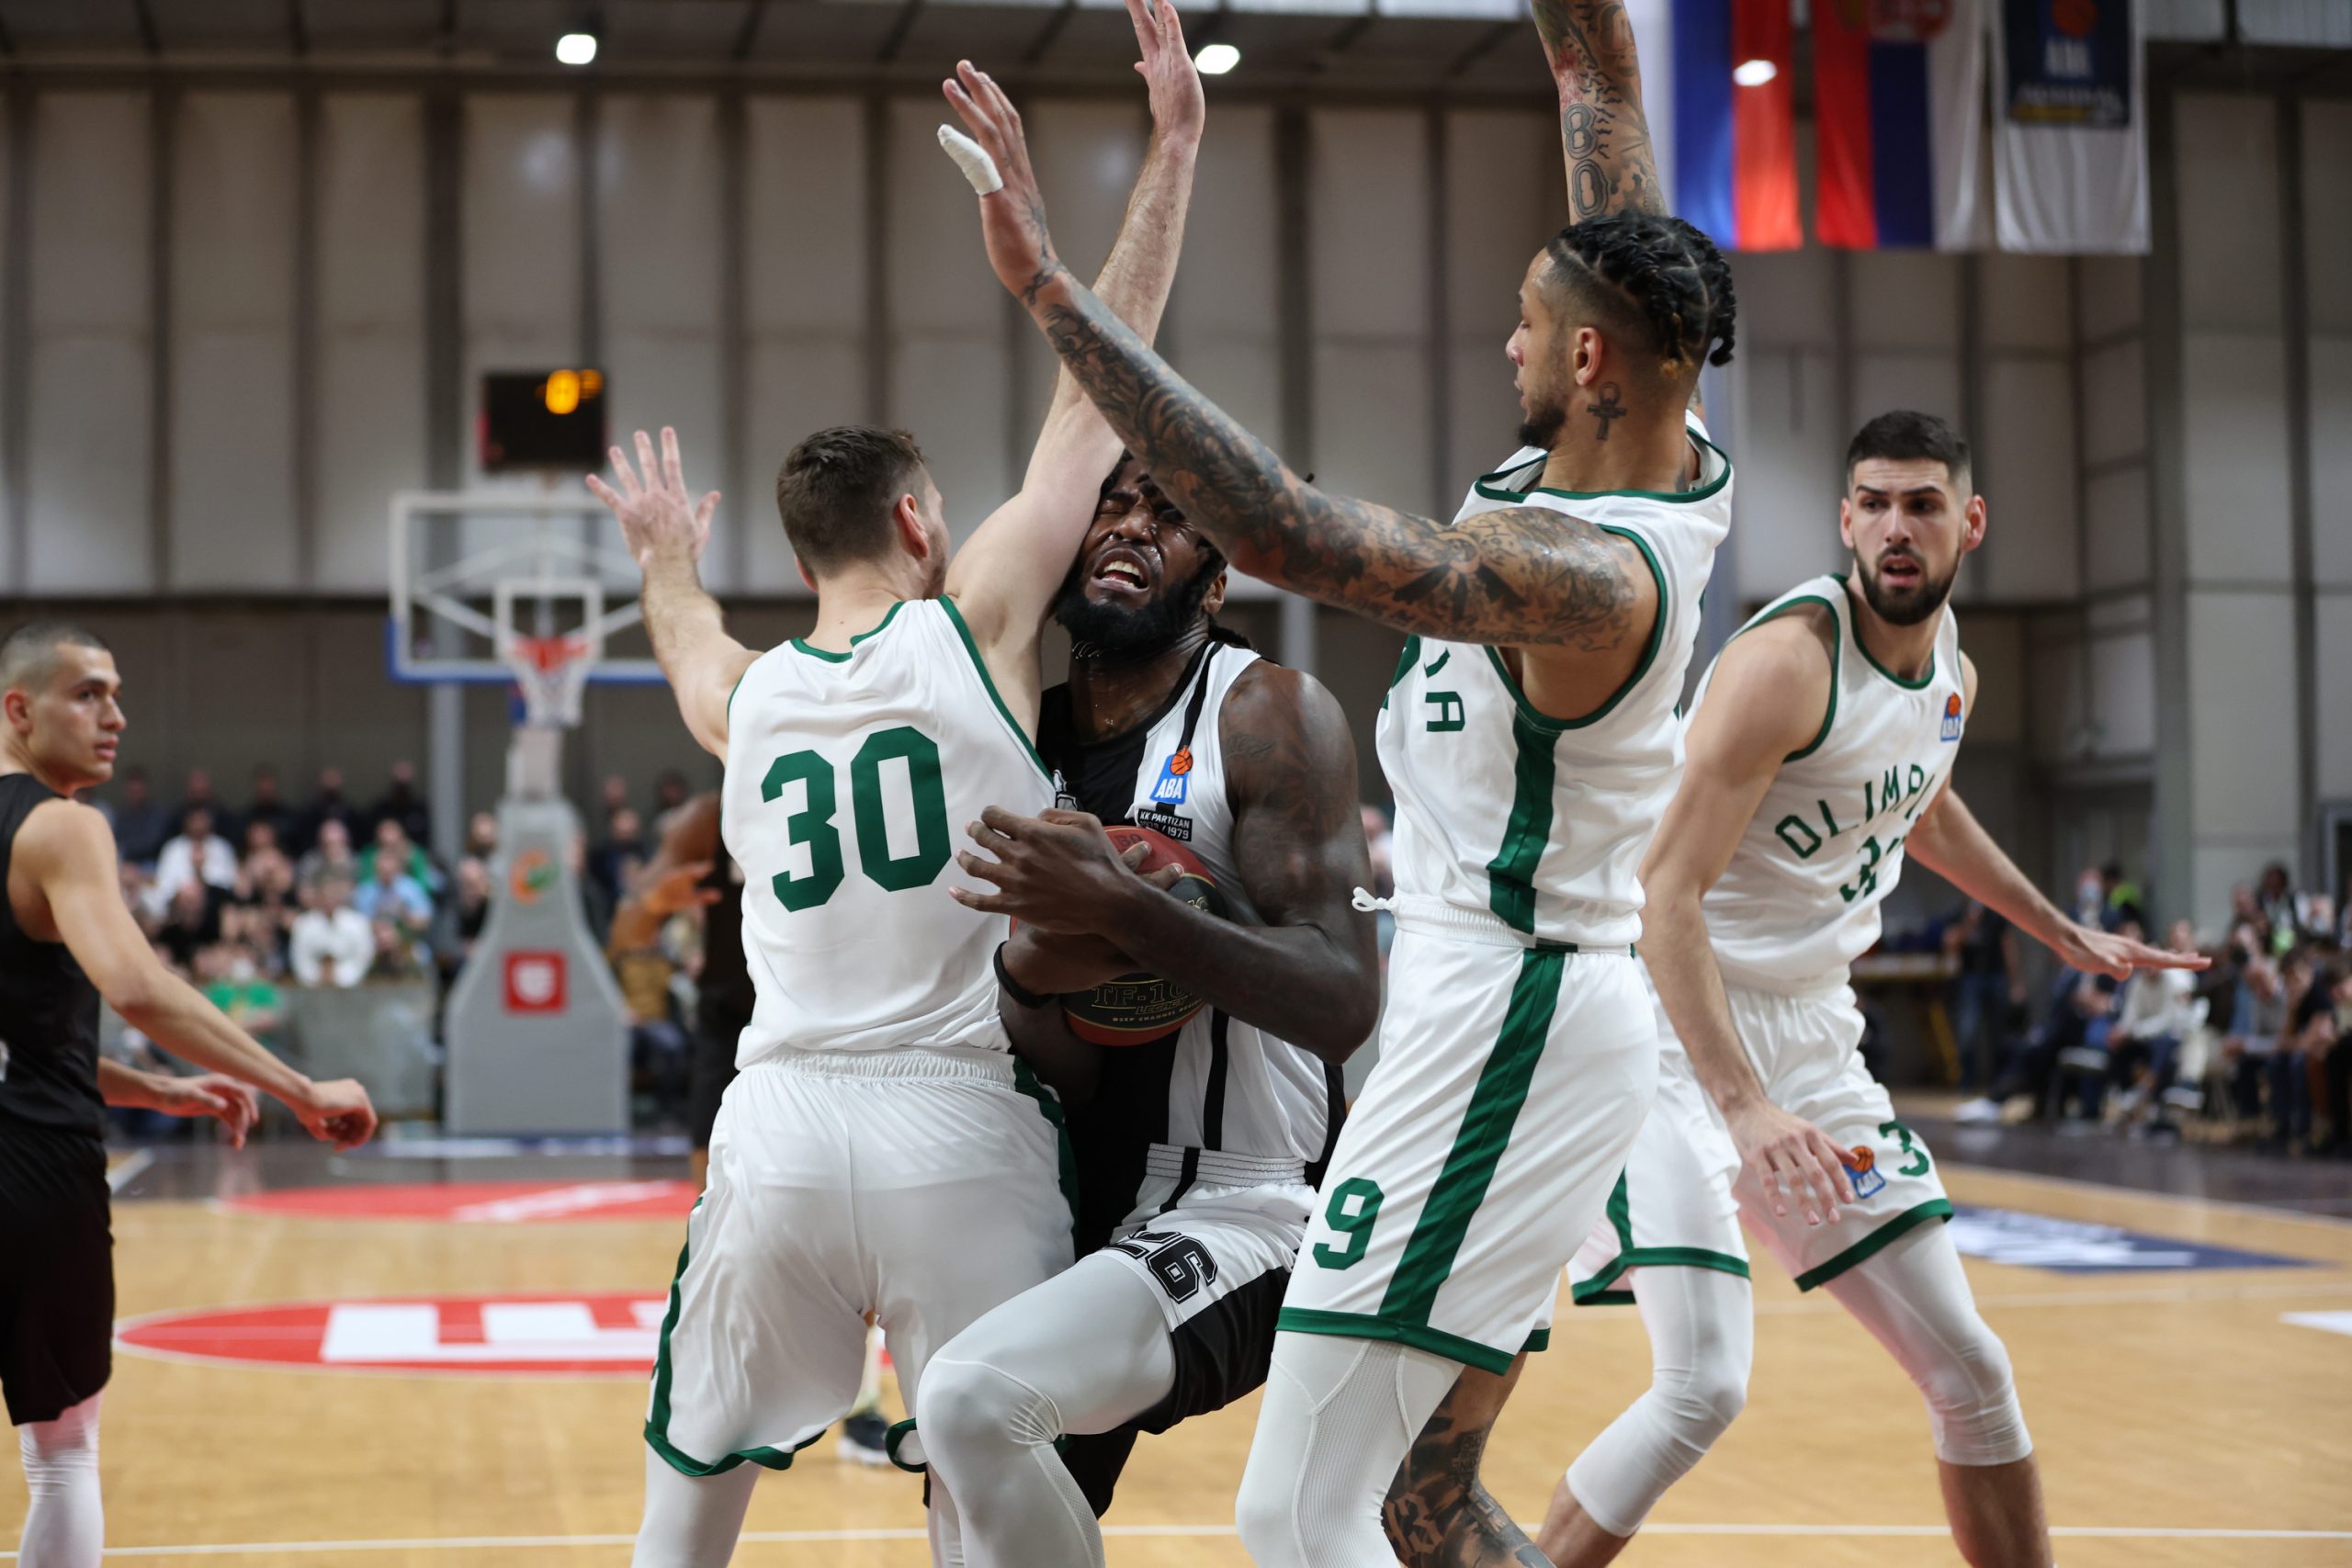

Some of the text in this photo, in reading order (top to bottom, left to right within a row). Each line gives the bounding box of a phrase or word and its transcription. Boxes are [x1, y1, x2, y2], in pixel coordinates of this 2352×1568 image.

[1154, 777, 1183, 799] ABA
[761, 726, 952, 913] 30
[1139, 810, 1191, 829] KK PARTIZAN
[1168, 826, 1190, 840] 1979
[1139, 1010, 1176, 1021] CHANNEL
[1312, 1177, 1385, 1270] 9
